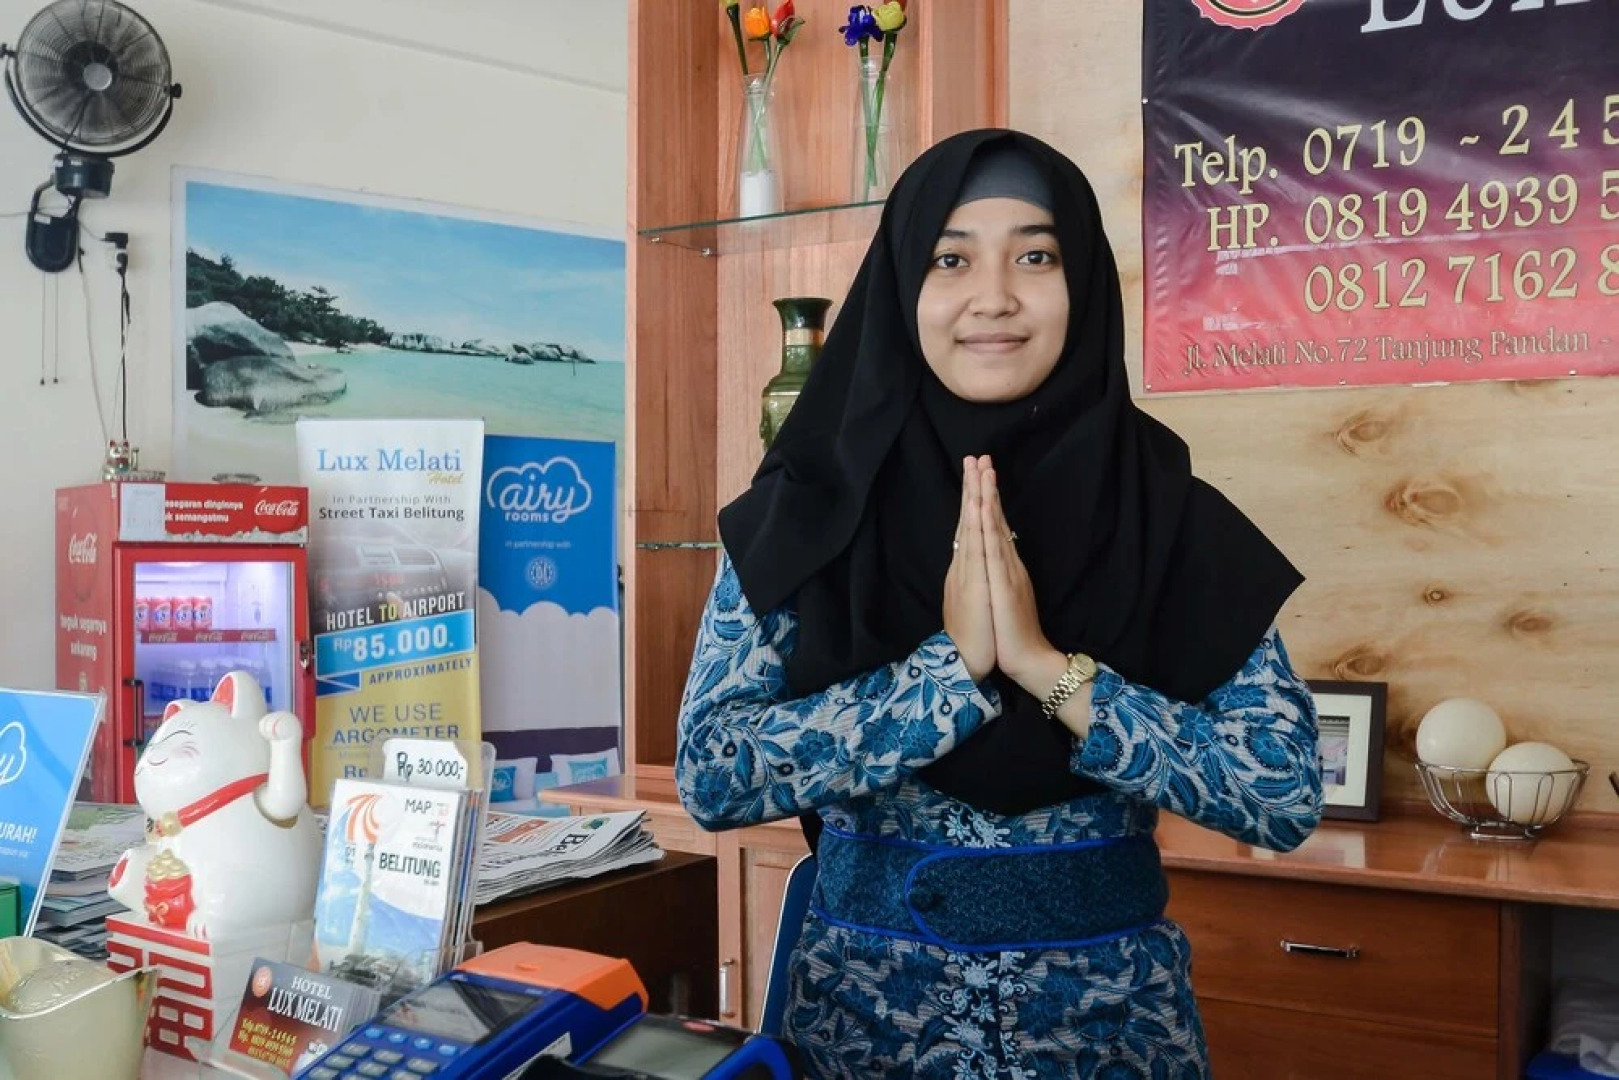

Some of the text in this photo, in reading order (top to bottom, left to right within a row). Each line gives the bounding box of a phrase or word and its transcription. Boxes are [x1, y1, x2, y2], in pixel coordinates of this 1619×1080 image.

[1174, 134, 1278, 195] Telp.
[1303, 116, 1426, 175] 0719
[1207, 204, 1278, 251] HP.
[1305, 187, 1427, 244] 0819
[1445, 174, 1578, 231] 4939
[1305, 257, 1427, 314] 0812
[1449, 247, 1578, 303] 7162
[1213, 340, 1287, 368] Melati
[1376, 333, 1482, 365] Tanjung
[1491, 326, 1589, 356] Pandan
[317, 448, 462, 471] Lux Melati
[427, 472, 464, 484] Hotel
[350, 495, 420, 506] Partnership
[424, 495, 451, 504] With
[499, 473, 576, 523] airy
[319, 507, 465, 521] Street Taxi Belitung
[505, 511, 549, 523] rooms
[326, 591, 465, 631] HOTEL TO AIRPORT
[369, 657, 472, 685] APPROXIMATELY
[350, 702, 442, 723] WE USE
[397, 751, 413, 781] Rp
[405, 798, 432, 814] MAP
[379, 851, 441, 879] BELITUNG
[291, 975, 332, 1000] HOTEL
[267, 987, 298, 1018] LUX
[295, 995, 343, 1032] MELATI
